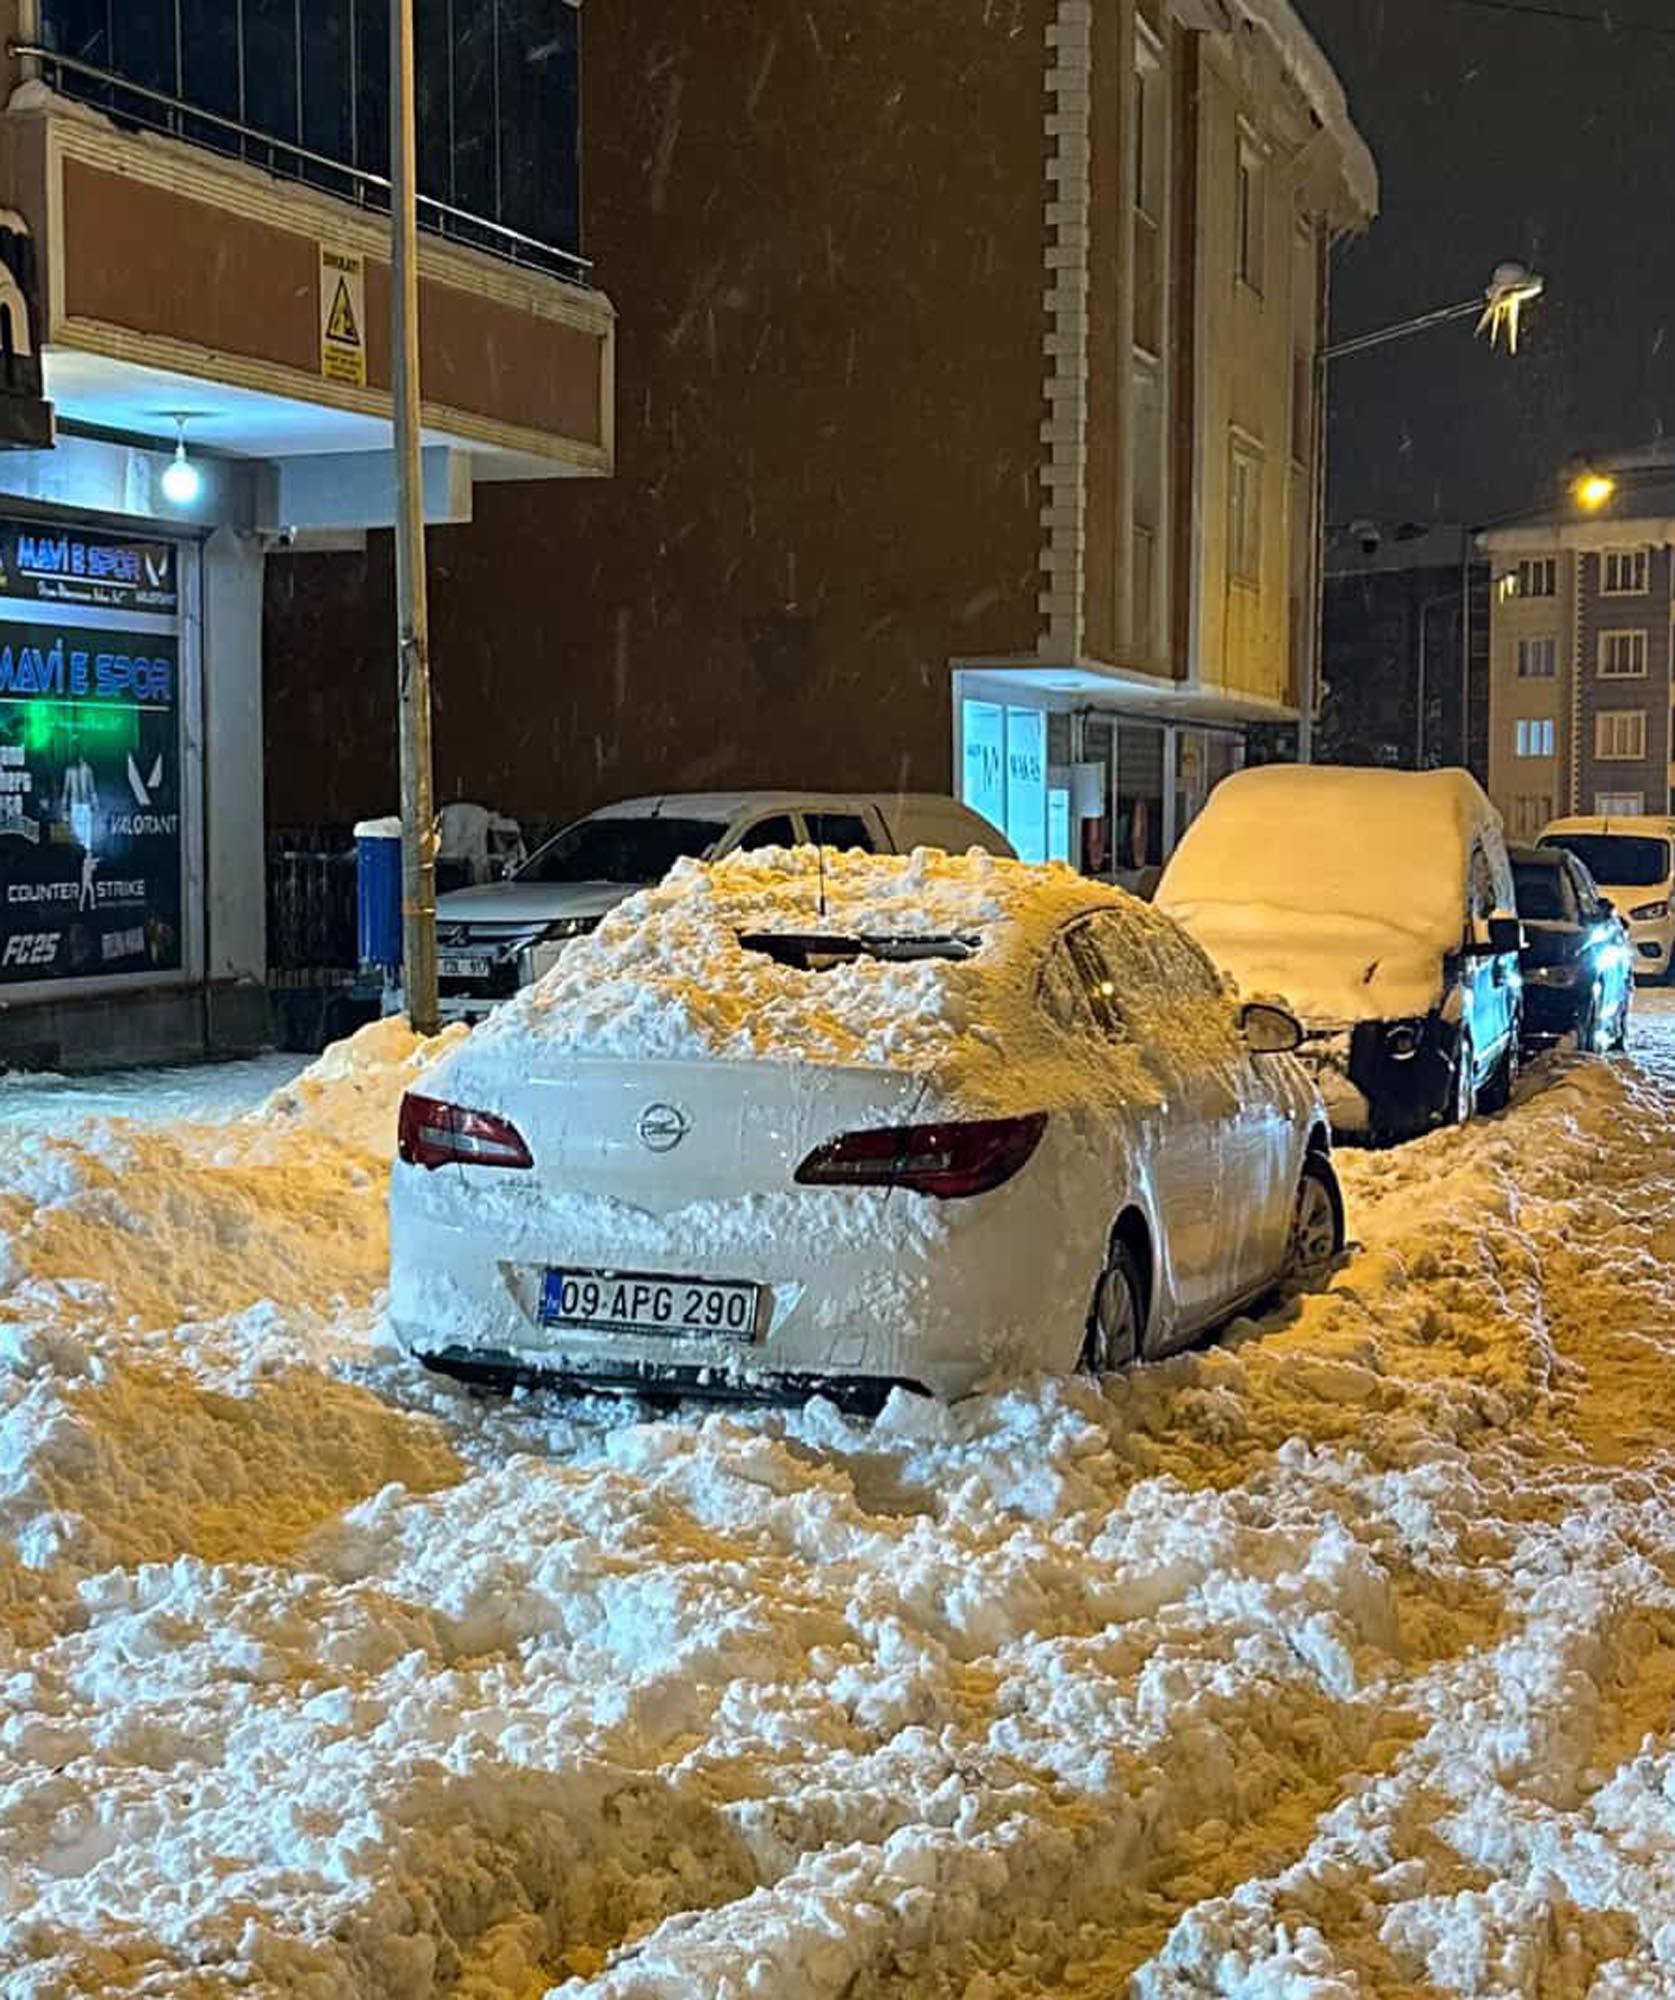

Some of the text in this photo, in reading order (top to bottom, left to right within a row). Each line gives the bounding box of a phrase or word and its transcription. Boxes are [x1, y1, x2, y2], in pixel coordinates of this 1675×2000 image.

[70, 650, 90, 695] E
[95, 654, 172, 701] SPOR
[110, 814, 179, 836] VALORANT
[7, 880, 145, 903] COUNTER STRIKE
[561, 1280, 600, 1317] 09
[611, 1284, 673, 1321] APG
[682, 1289, 747, 1328] 290
